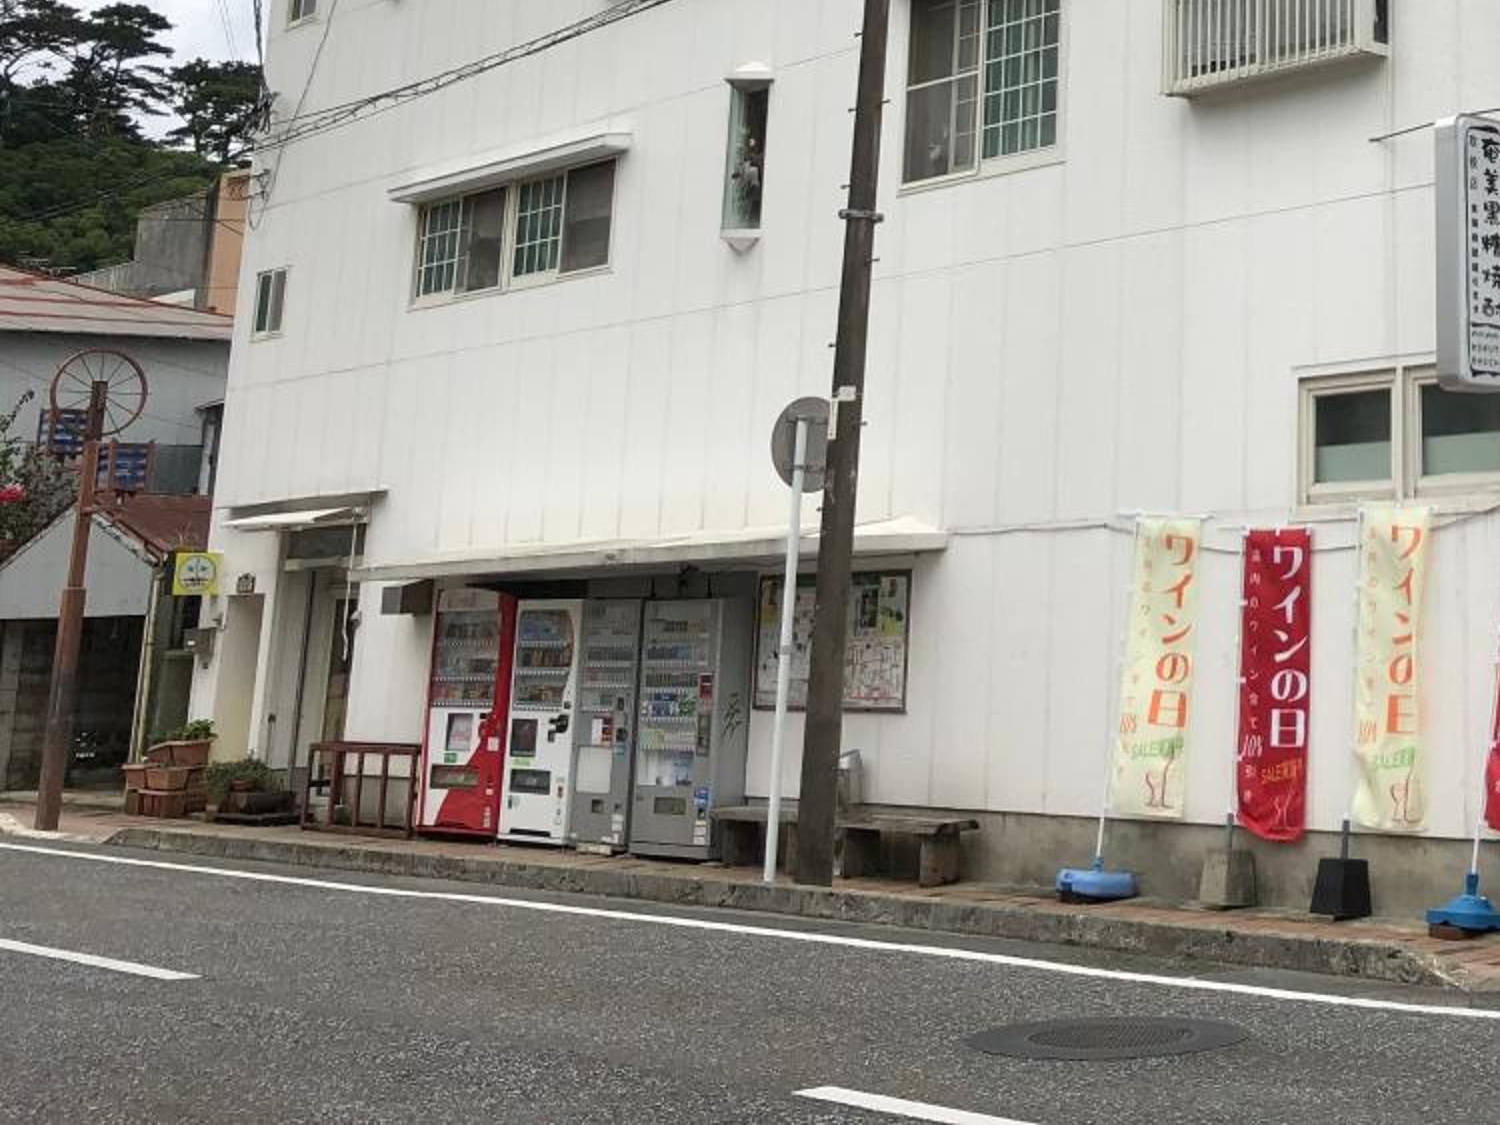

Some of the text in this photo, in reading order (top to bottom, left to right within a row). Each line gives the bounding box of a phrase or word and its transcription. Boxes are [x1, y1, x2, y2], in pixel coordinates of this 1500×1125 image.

[1147, 533, 1194, 728] ワインの日
[1270, 546, 1309, 747] ワインの日
